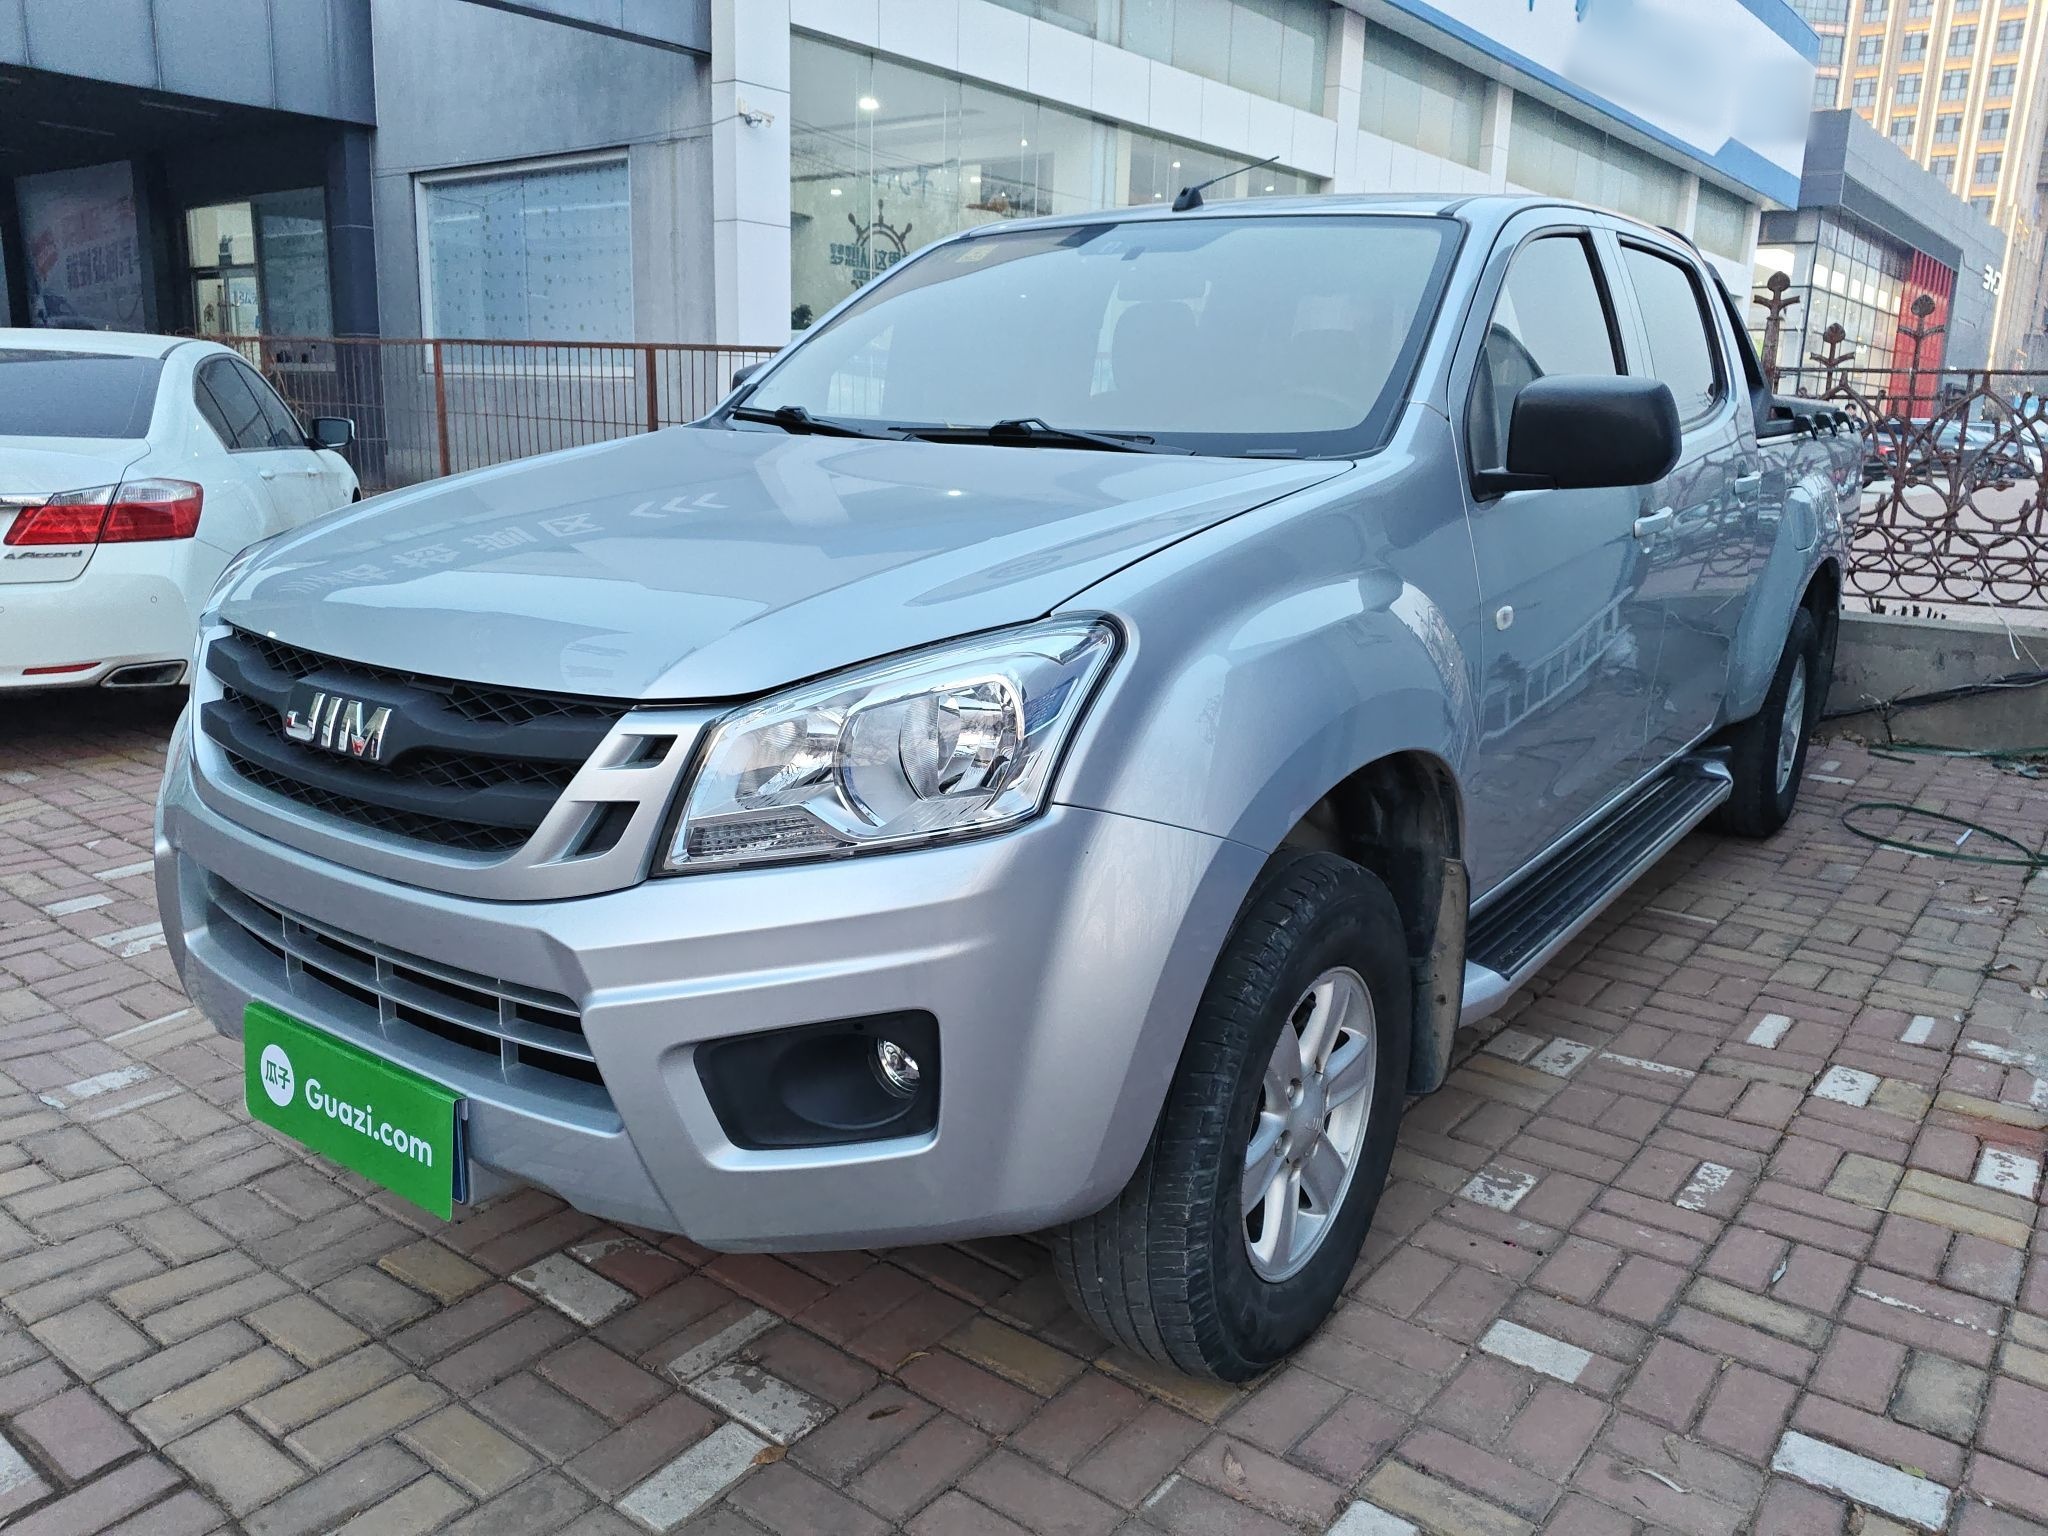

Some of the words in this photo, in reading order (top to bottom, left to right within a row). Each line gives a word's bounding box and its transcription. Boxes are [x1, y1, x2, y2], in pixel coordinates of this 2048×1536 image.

[286, 692, 392, 760] JIM
[265, 1059, 291, 1090] 瓜子
[304, 1078, 433, 1167] Guazi.com
